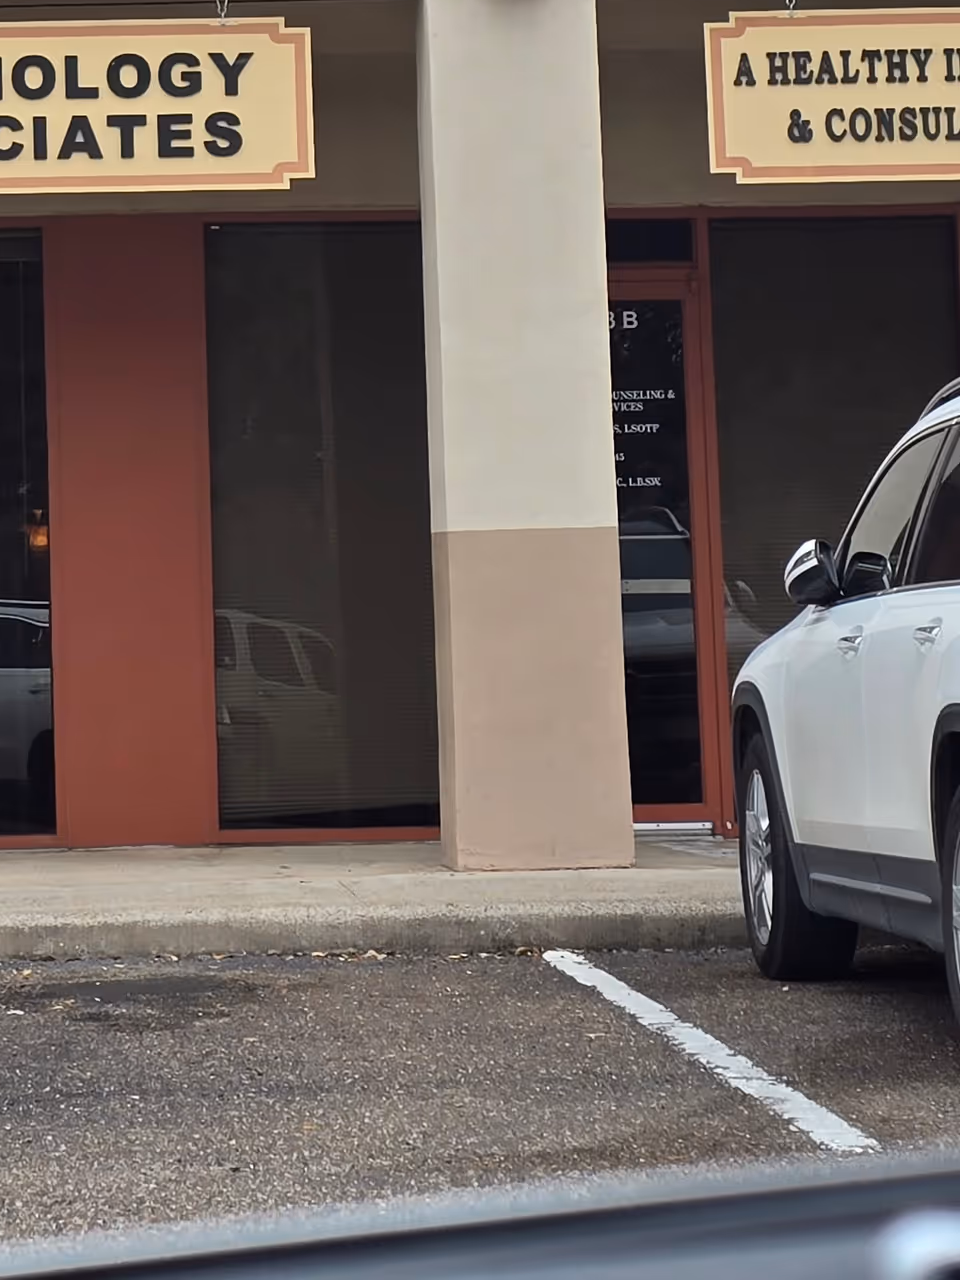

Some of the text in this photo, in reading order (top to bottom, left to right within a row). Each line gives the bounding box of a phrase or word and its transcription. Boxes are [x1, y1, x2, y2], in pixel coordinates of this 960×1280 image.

[733, 47, 960, 87] A HEALTHY I
[787, 106, 960, 144] & CONSUL
[623, 311, 639, 329] B
[612, 389, 676, 401] UNSELING &
[613, 401, 644, 412] VICES
